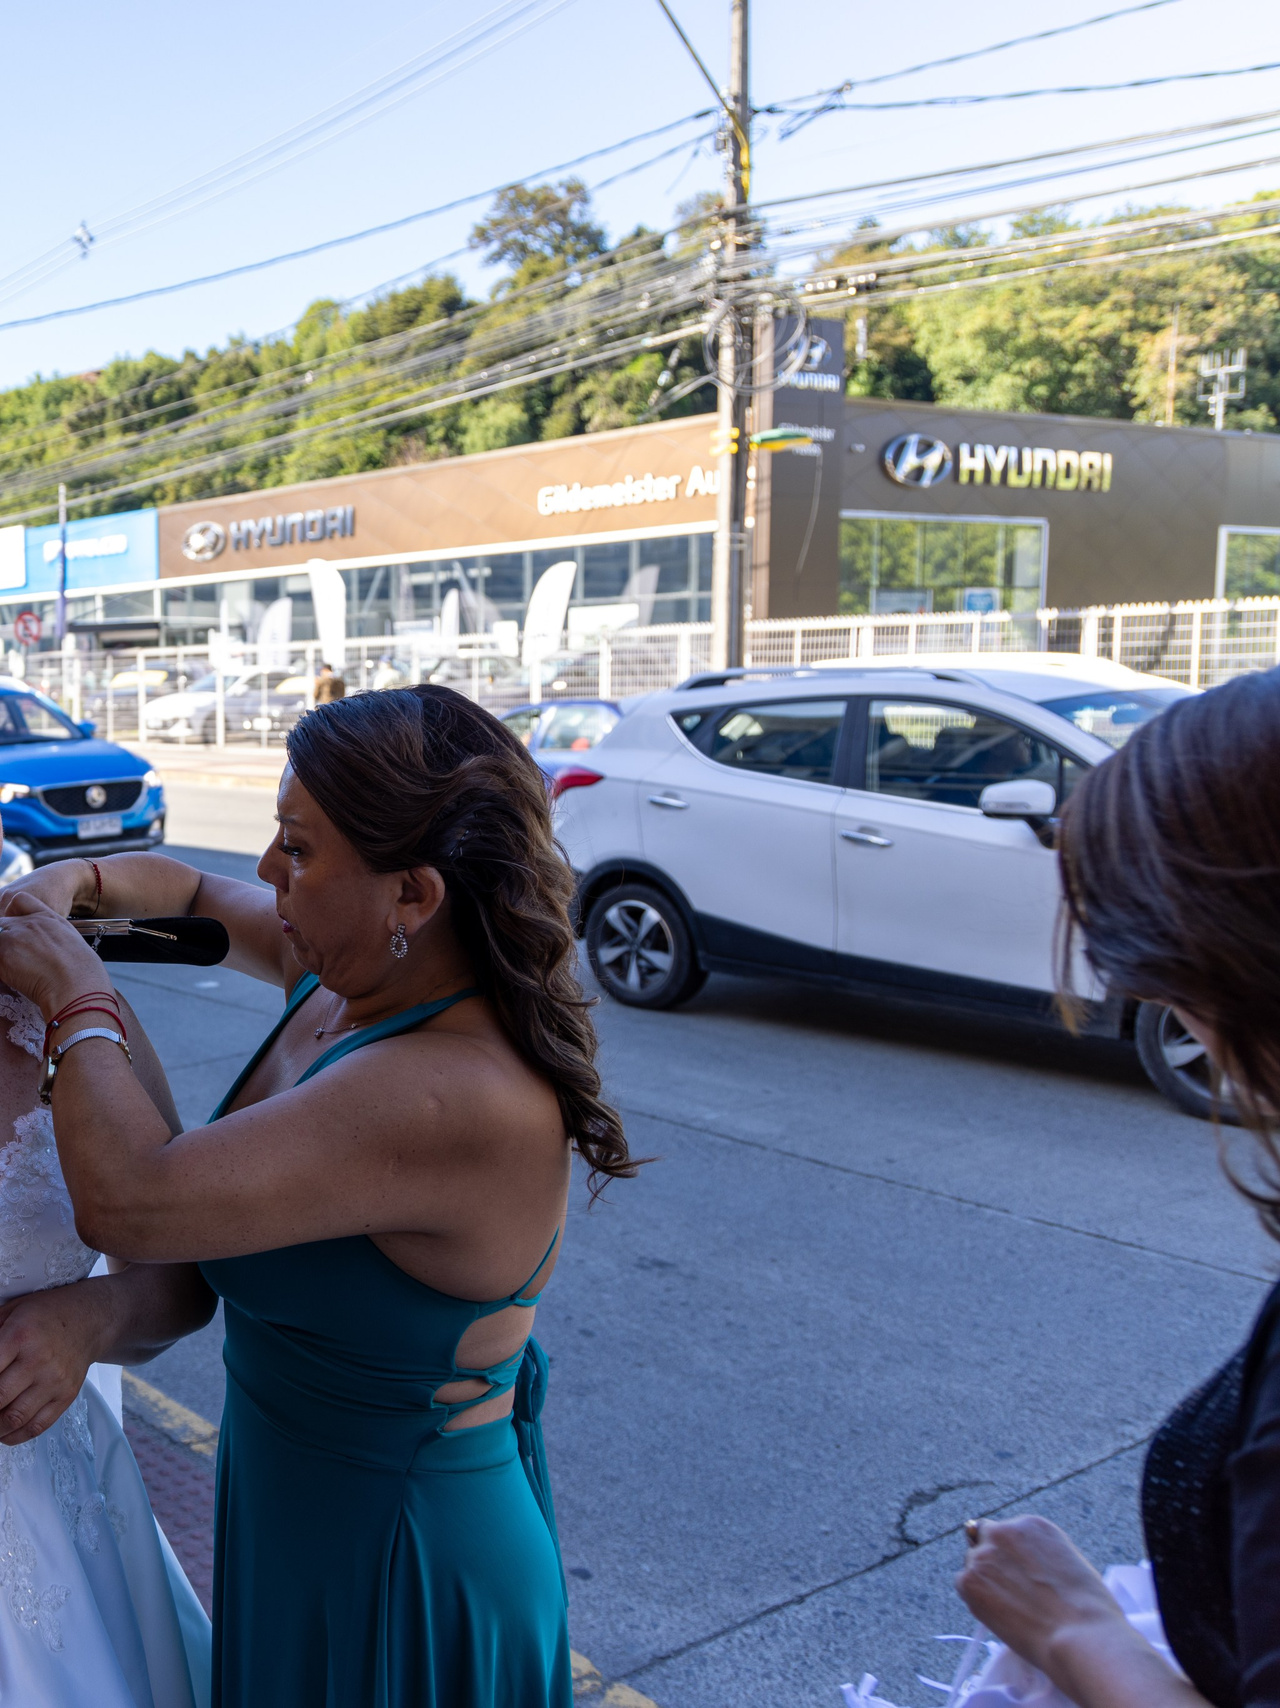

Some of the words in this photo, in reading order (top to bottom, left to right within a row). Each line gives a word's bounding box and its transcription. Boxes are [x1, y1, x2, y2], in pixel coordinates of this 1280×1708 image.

[537, 472, 682, 516] Gildemeister
[685, 465, 721, 497] Au
[958, 442, 1113, 493] HYUNDAI
[229, 504, 355, 550] HYUNDAI
